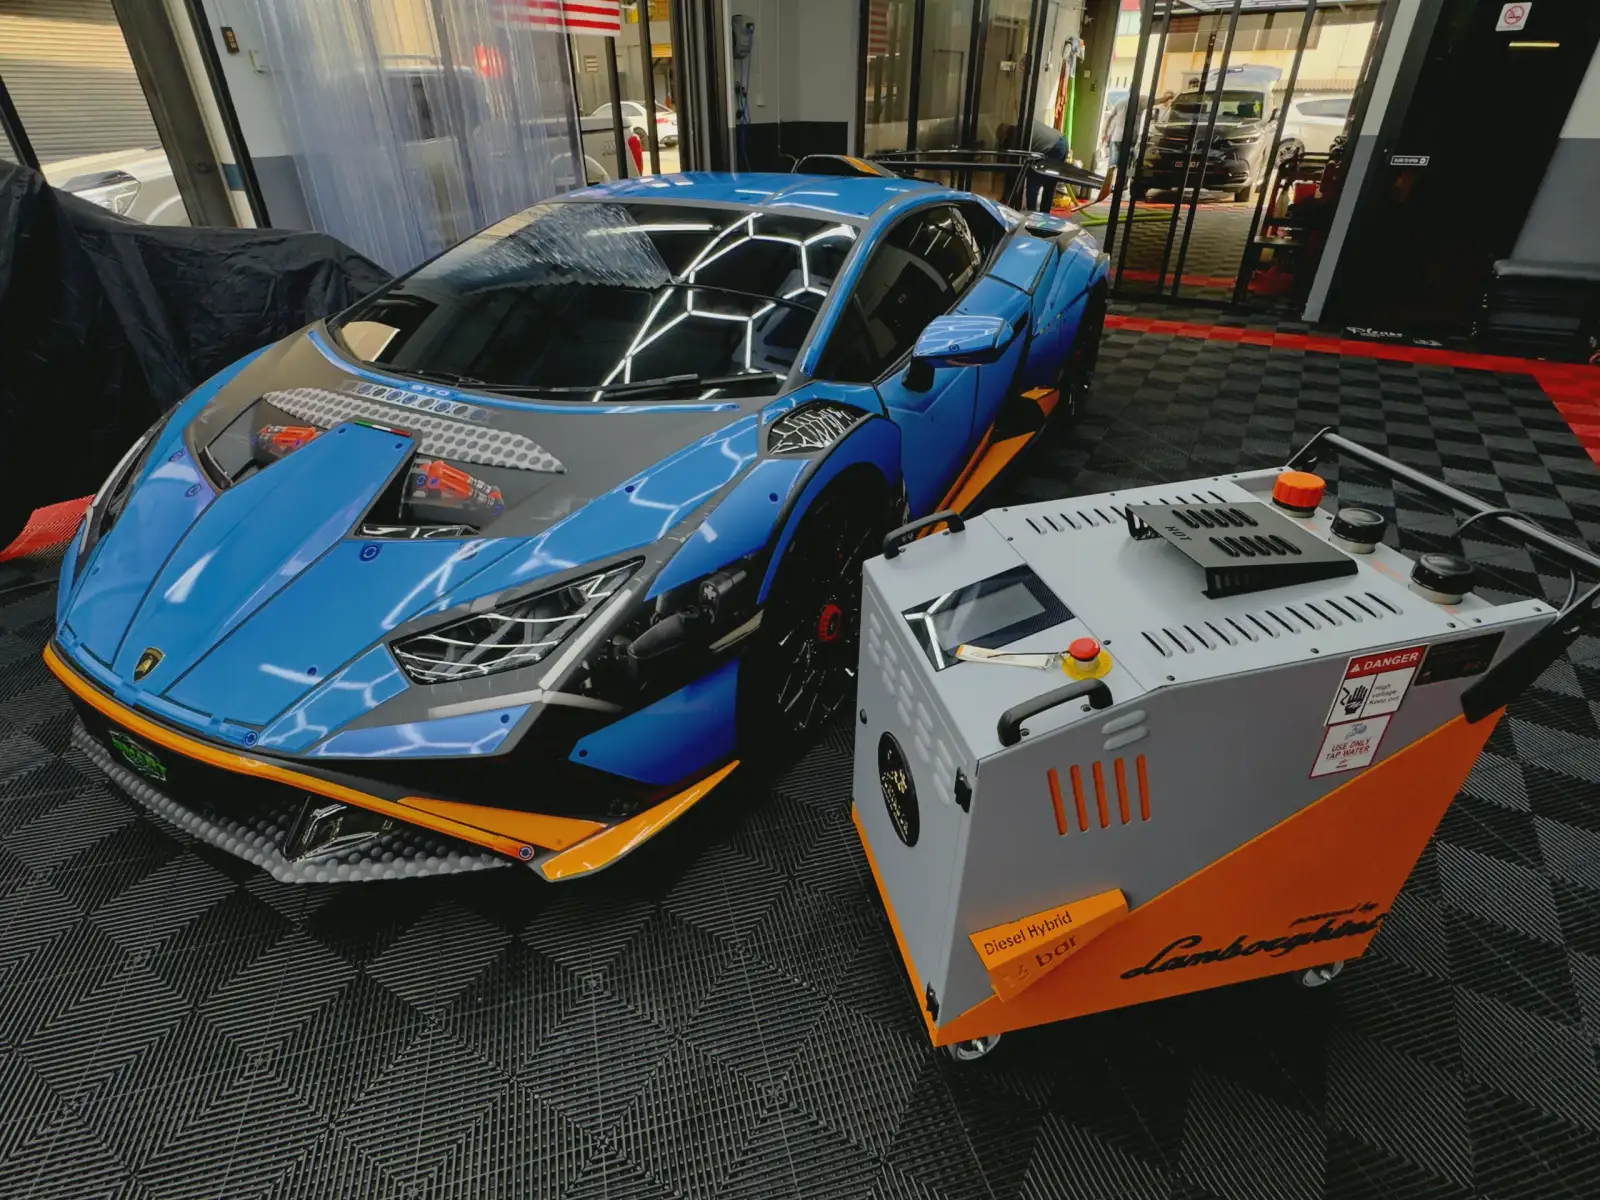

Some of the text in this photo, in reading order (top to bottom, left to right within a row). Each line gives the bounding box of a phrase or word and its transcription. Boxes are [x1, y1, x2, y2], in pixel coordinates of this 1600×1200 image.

[1364, 651, 1420, 671] DANGER
[1326, 745, 1371, 761] TAP WATER
[1331, 737, 1371, 752] USE ONLY
[984, 911, 1073, 956] Diesel Hybrid
[1120, 912, 1389, 980] Lamborghini
[1034, 934, 1078, 968] bar
